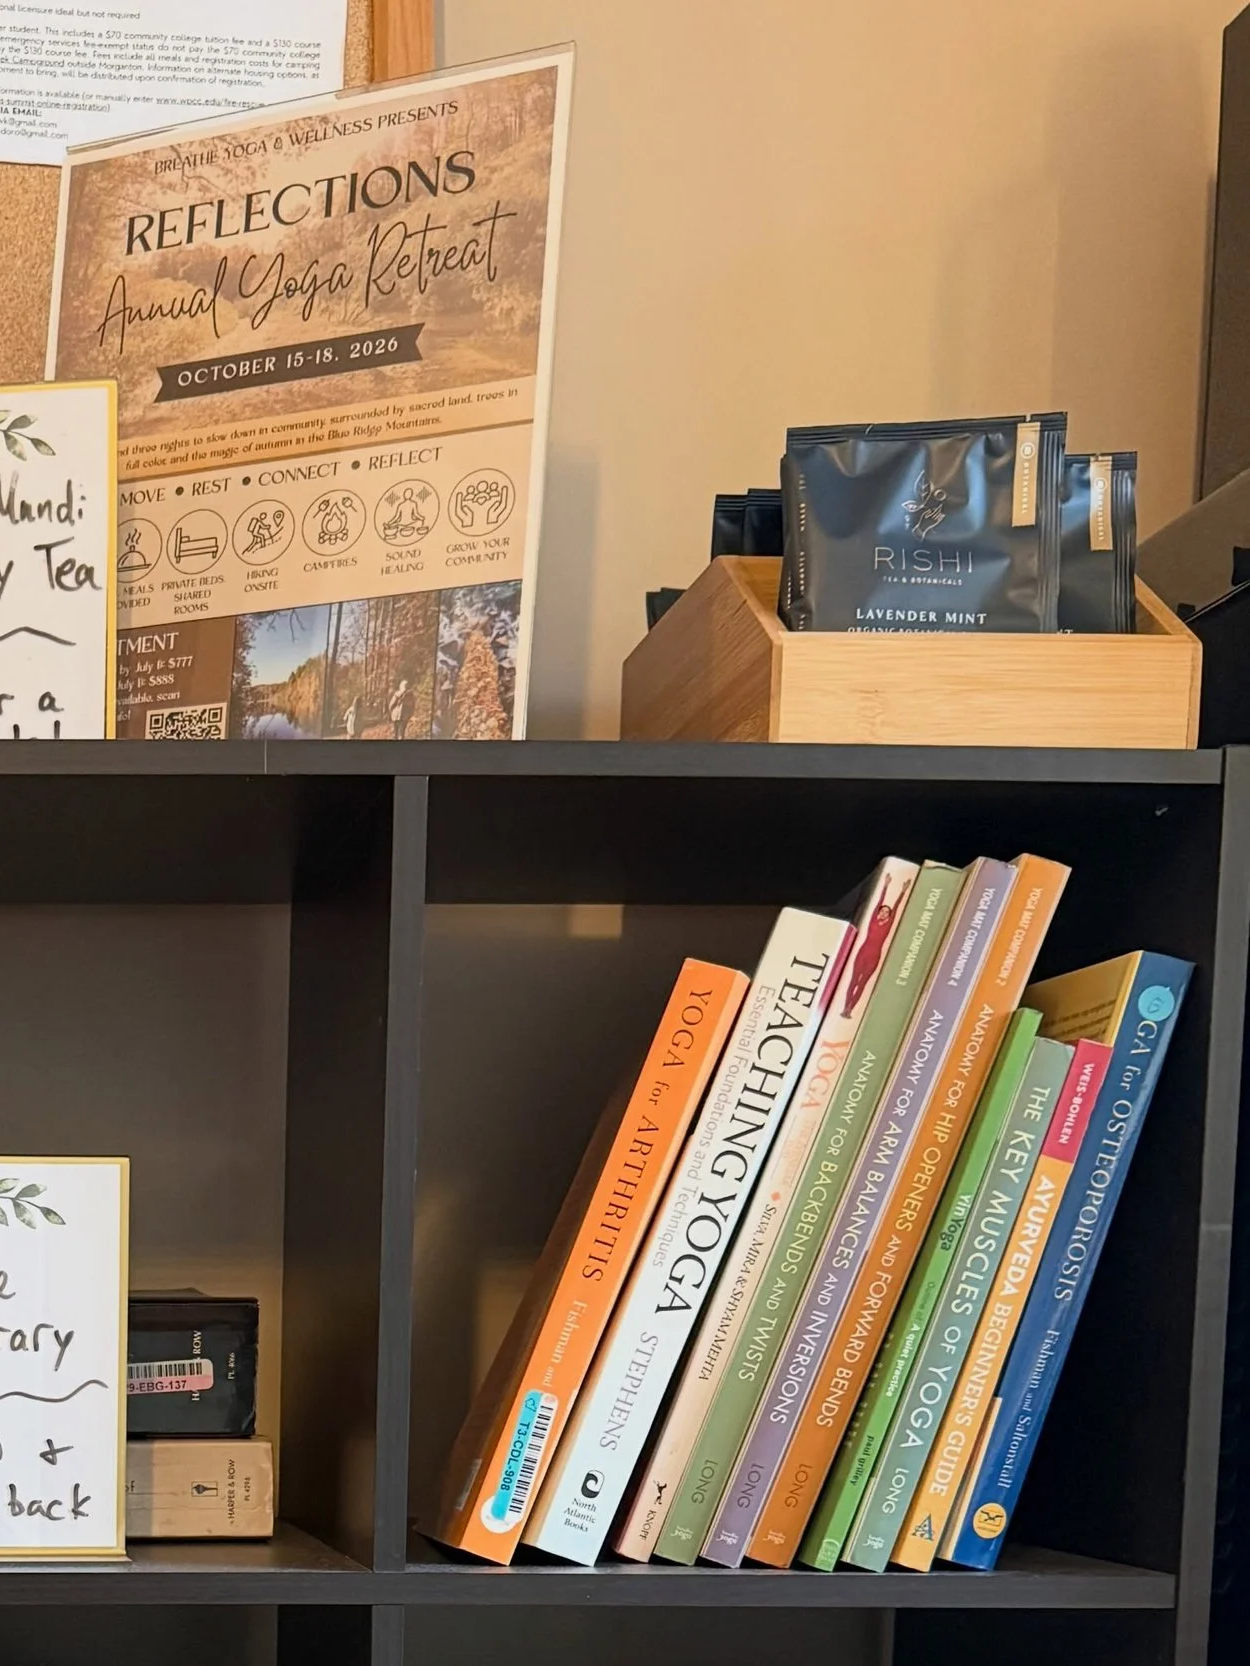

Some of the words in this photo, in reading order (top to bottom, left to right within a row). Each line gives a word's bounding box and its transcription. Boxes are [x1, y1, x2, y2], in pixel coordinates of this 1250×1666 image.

[12, 107, 42, 117] EMAIL:
[155, 149, 218, 175] BREATHE
[223, 142, 267, 160] YOGA
[289, 118, 373, 147] WELLNESS
[377, 100, 458, 129] PRESENTS
[124, 149, 476, 256] REFLECTIONS
[98, 255, 229, 354] Annual
[238, 252, 353, 329] Yoga
[365, 199, 518, 308] Retreat
[177, 356, 277, 387] OCTOBER
[350, 336, 399, 358] 2026
[120, 487, 167, 506] MOVE
[191, 477, 232, 495] REST
[258, 461, 341, 487] CONNECT
[368, 446, 443, 470] REFLECT
[33, 536, 102, 592] Tea
[303, 556, 358, 572] CAMPFIRES
[385, 549, 422, 561] SOUND
[444, 550, 509, 568] COMMUNITY
[446, 542, 479, 555] GROW
[482, 537, 510, 550] YOUR
[874, 546, 973, 573] RISHI
[162, 578, 198, 591] PRIVATE
[243, 580, 278, 592] ONSITE
[246, 568, 278, 580] HIKING
[381, 561, 424, 576] HEALING
[883, 575, 898, 584] TEA
[910, 577, 963, 586] BOTANICALS
[174, 589, 211, 601] SHARED
[174, 602, 209, 614] ROOMS
[856, 608, 937, 622] LAVENDER
[945, 612, 987, 625] MINT
[38, 691, 64, 712] a
[663, 988, 712, 1071] YOGA
[712, 952, 831, 1186] TEACHING
[649, 1079, 670, 1105] for
[1057, 1061, 1095, 1145] WEIS-BOHLEN
[582, 1112, 661, 1284] ARTHRITIS
[656, 1189, 731, 1317] YOGA
[996, 1173, 1056, 1297] AYURVEDA
[953, 1297, 1012, 1426] BEGINNER'S
[599, 1331, 661, 1452] STEPHENS
[497, 1420, 532, 1496] T3-CDL-908
[929, 1426, 972, 1496] GUIDE
[8, 1483, 92, 1521] back
